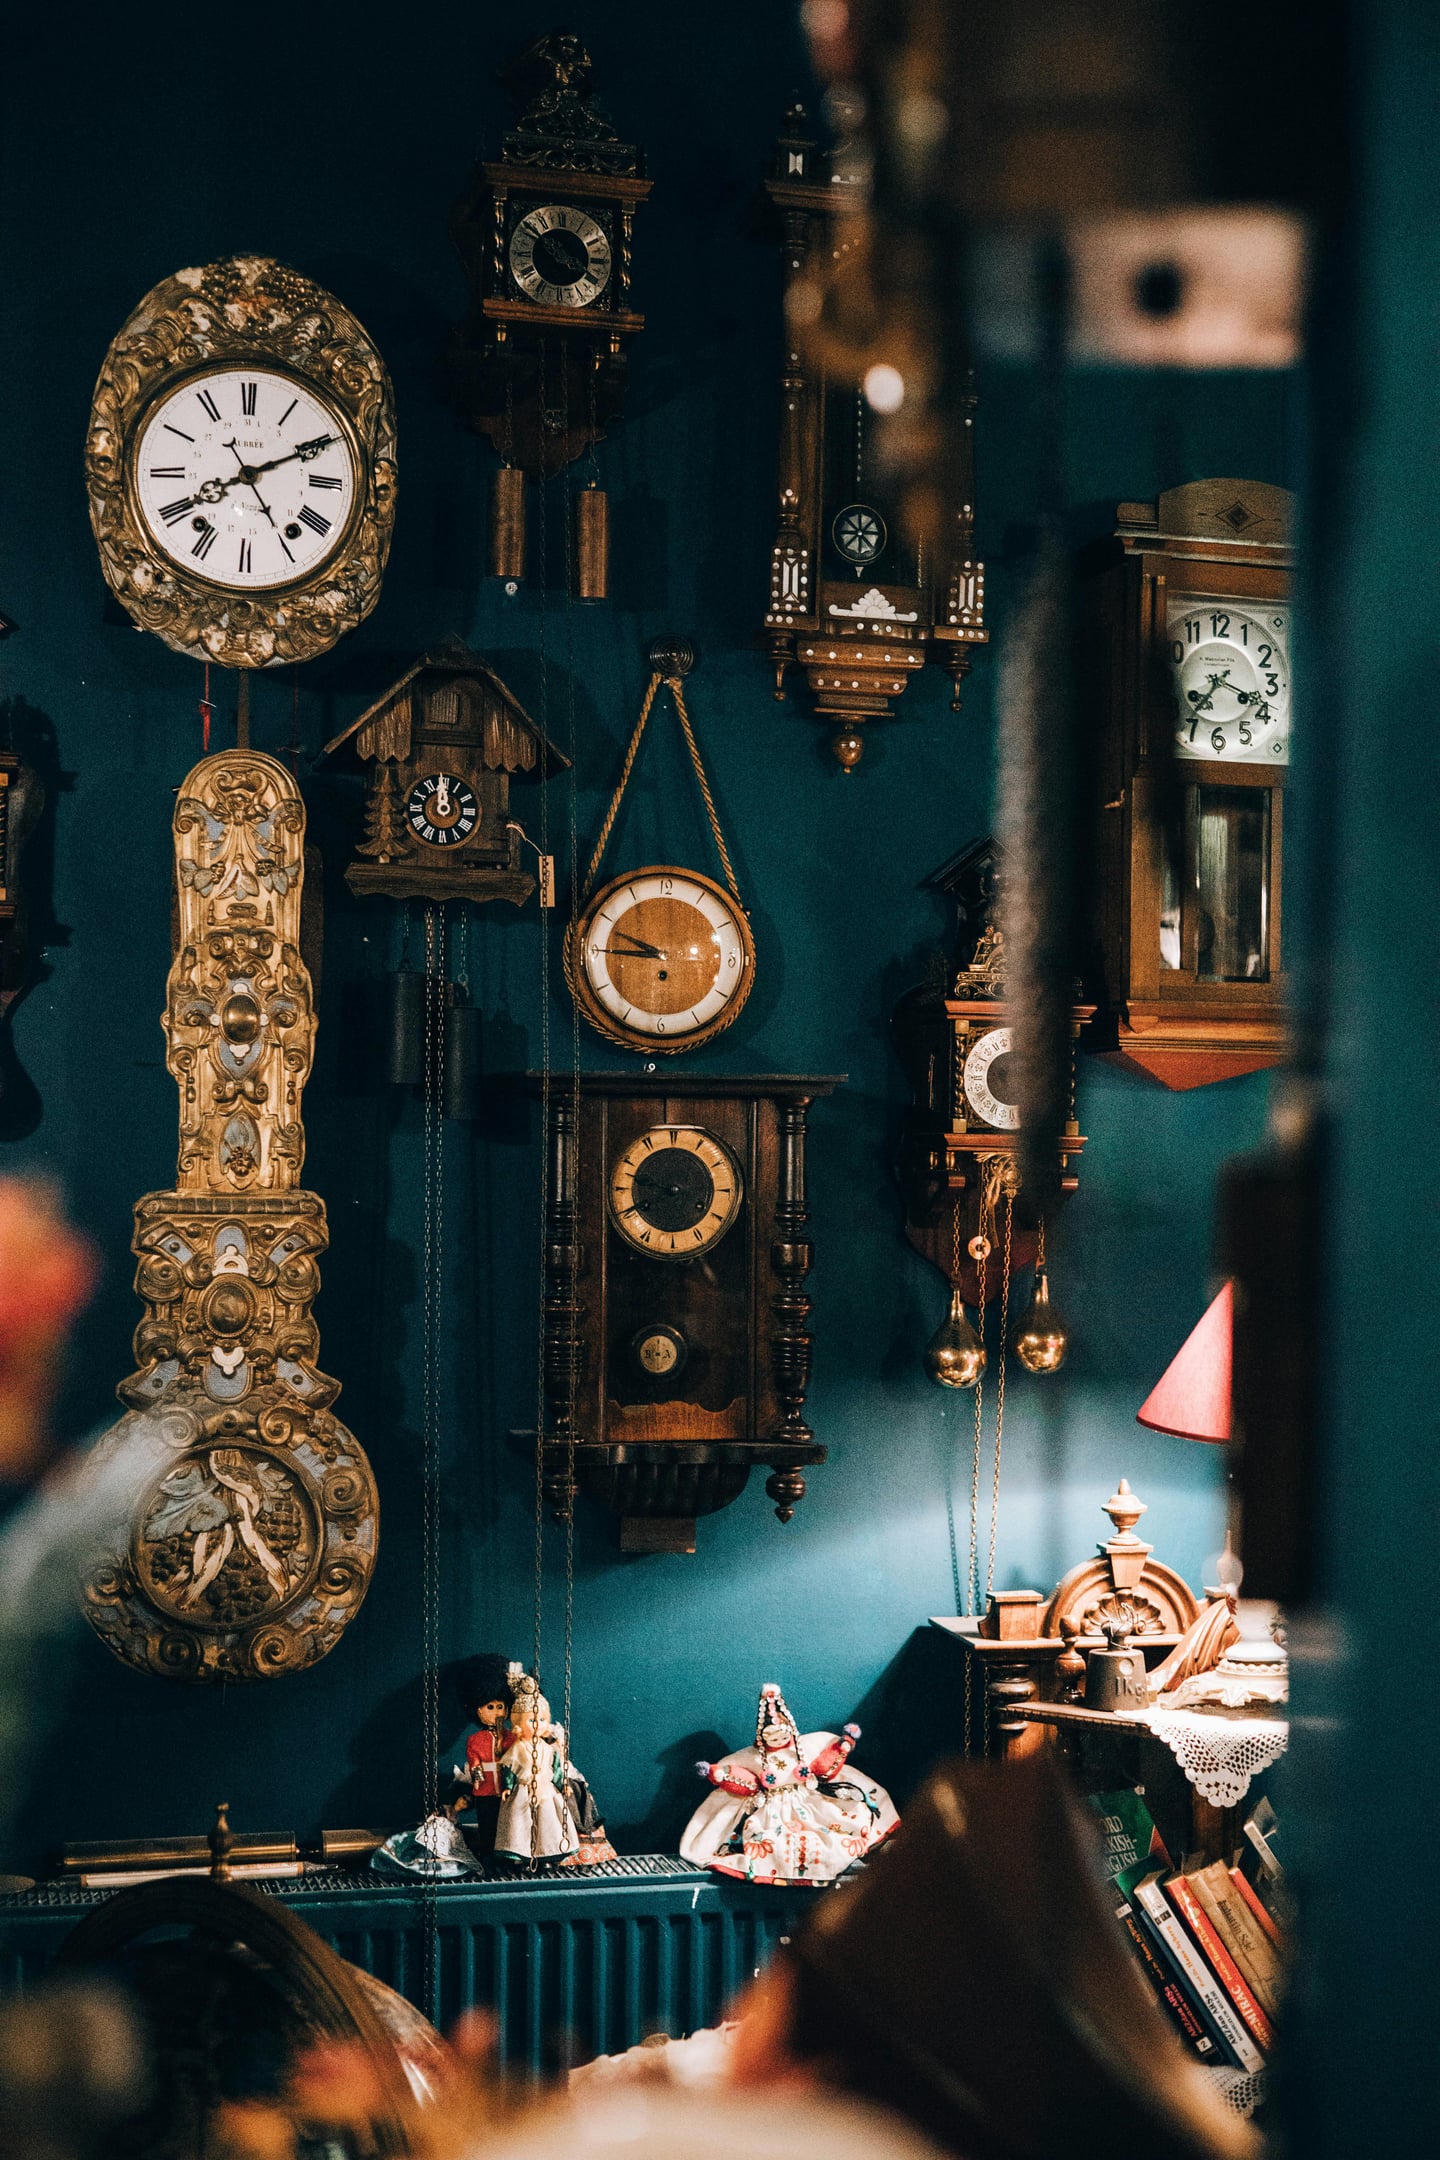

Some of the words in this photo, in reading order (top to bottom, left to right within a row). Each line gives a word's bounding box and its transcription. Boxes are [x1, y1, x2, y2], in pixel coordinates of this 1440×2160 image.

[241, 382, 257, 416] XII
[1184, 621, 1200, 644] 11
[1209, 614, 1230, 638] 12
[1240, 624, 1248, 646] 1
[1257, 644, 1272, 668] 2
[1265, 672, 1279, 697] 3
[1255, 701, 1271, 725] 4
[1185, 717, 1199, 743] 7
[1211, 727, 1226, 751] 6
[1239, 720, 1253, 745] 5
[413, 789, 427, 801] X
[423, 779, 436, 794] XI
[453, 782, 461, 793] I
[460, 793, 473, 803] II
[409, 803, 423, 812] IX
[463, 807, 476, 816] III
[438, 830, 447, 843] VI
[451, 828, 461, 841] V
[660, 878, 673, 896] 12
[656, 1017, 665, 1034] 6
[1200, 2040, 1208, 2049] 2
